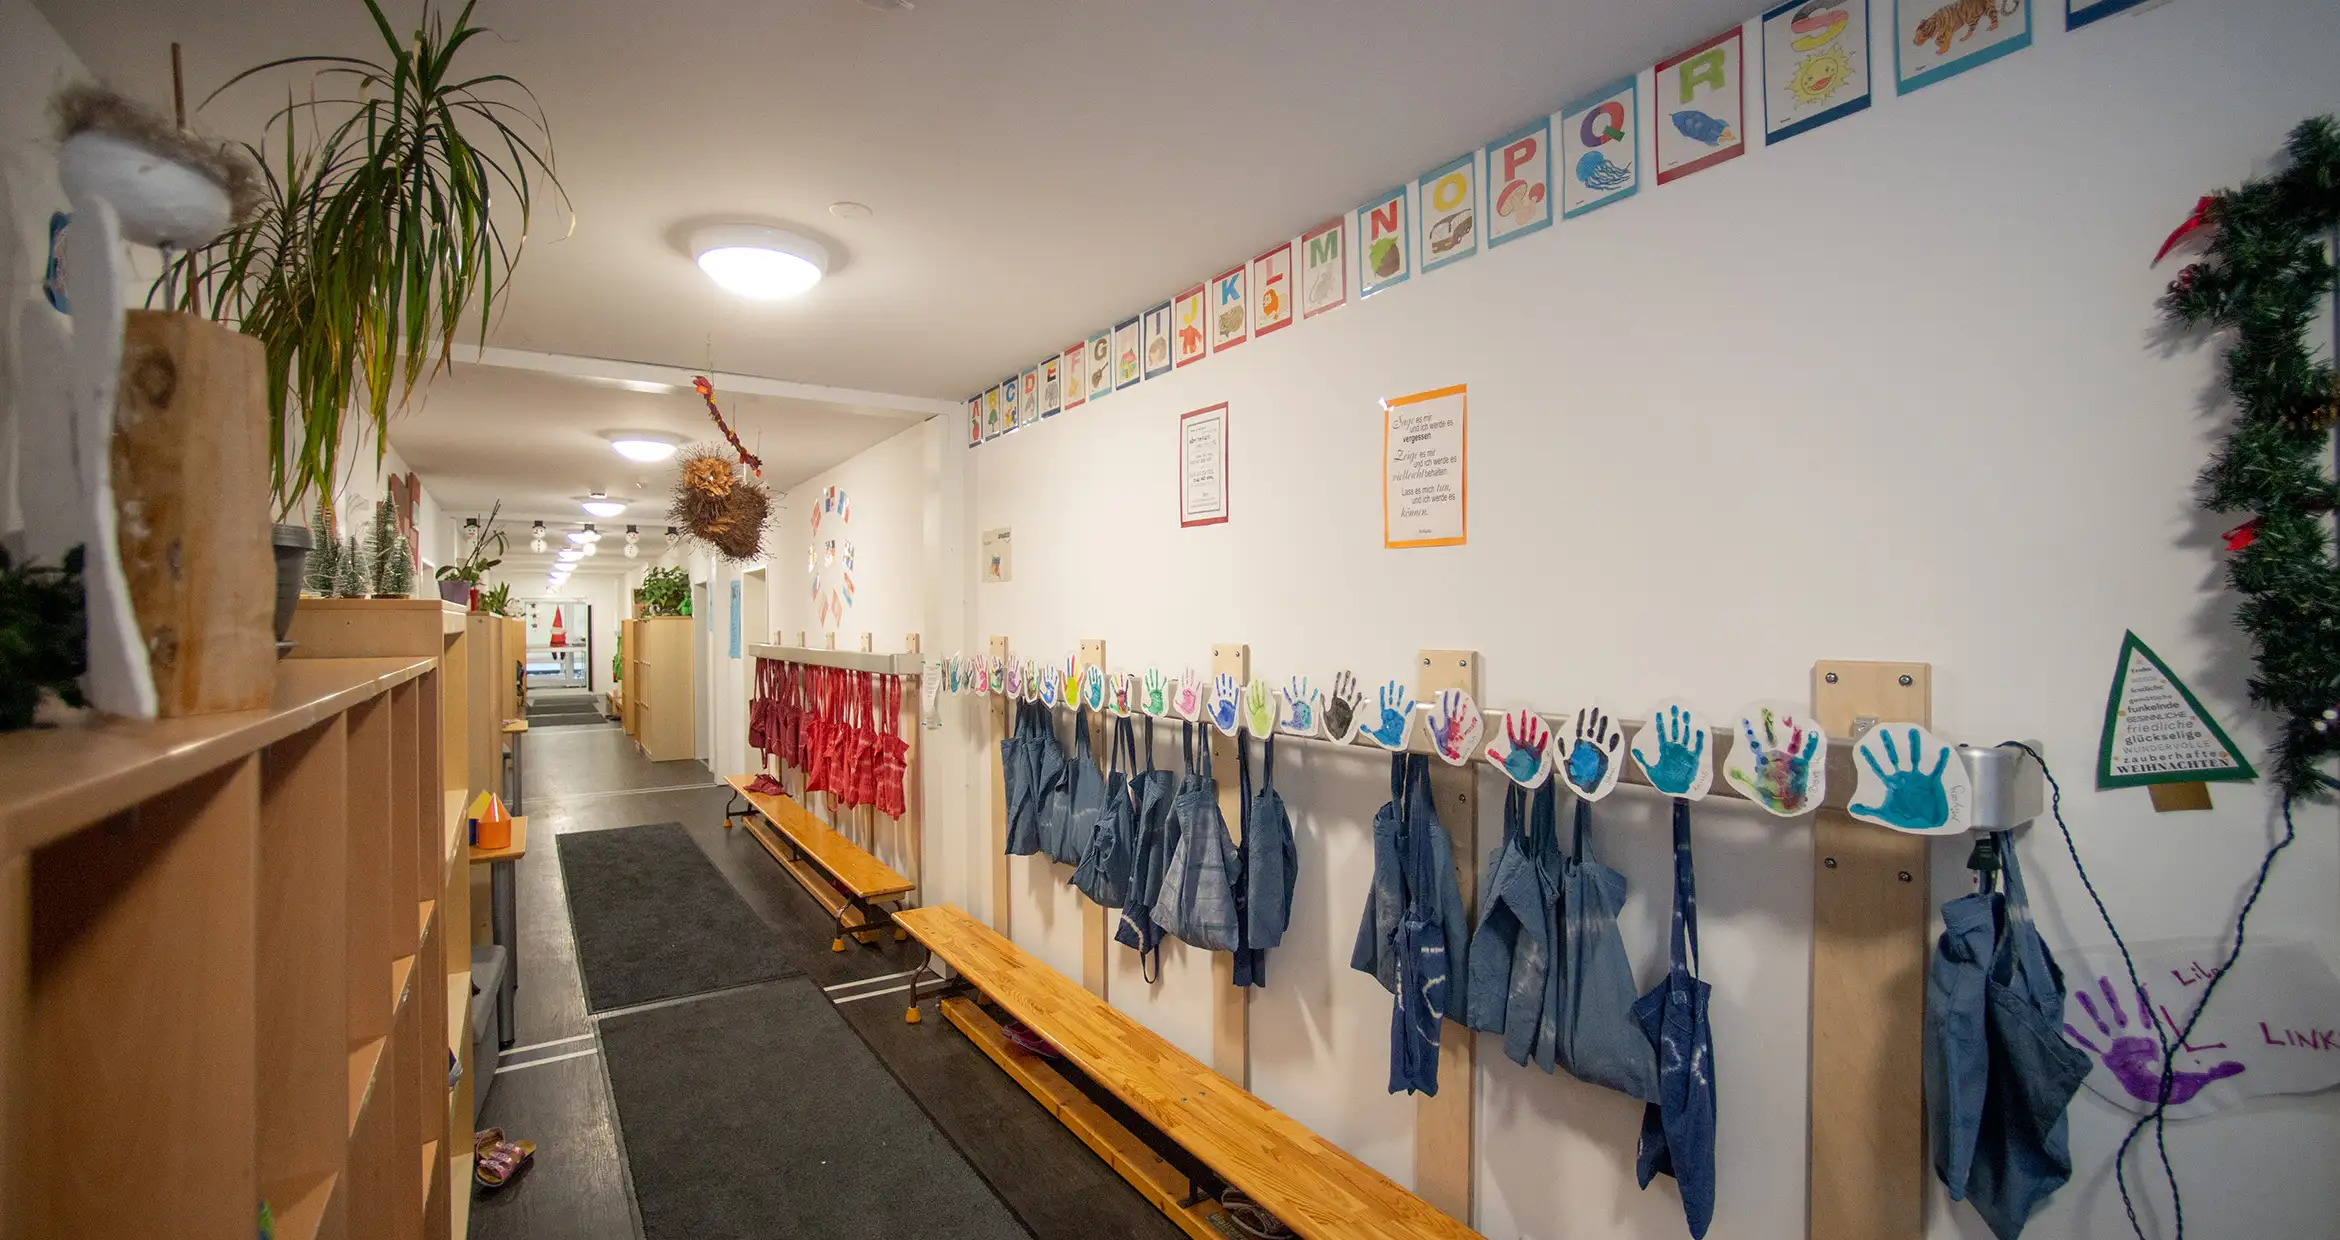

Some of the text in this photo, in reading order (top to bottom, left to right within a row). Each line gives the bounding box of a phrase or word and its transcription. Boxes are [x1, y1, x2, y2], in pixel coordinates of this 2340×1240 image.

[1791, 0, 1849, 52] S
[1678, 47, 1727, 105] R
[1580, 101, 1625, 147] Q
[1504, 138, 1537, 182] P
[1433, 172, 1467, 212] O
[1370, 200, 1398, 240] N
[1310, 229, 1338, 269] M
[1265, 258, 1283, 286] L
[1222, 273, 1240, 305] K
[1184, 296, 1197, 324] J
[1156, 311, 1161, 335] I
[1094, 338, 1107, 361] G
[1047, 360, 1057, 382] E
[1071, 350, 1081, 374] F
[1006, 382, 1016, 402] C
[1025, 373, 1035, 394] D
[972, 400, 980, 419] A
[989, 391, 998, 409] B
[1410, 419, 1453, 433] und ich werde es
[1423, 412, 1432, 422] mir
[1414, 455, 1457, 468] und ich werde es
[1392, 468, 1424, 482] vielleicht
[1401, 487, 1413, 497] Lass
[1415, 487, 1421, 495] es
[1422, 485, 1434, 494] mich
[1412, 496, 1421, 504] und
[1431, 492, 1447, 502] werde
[1448, 493, 1456, 501] es
[2127, 701, 2180, 713] funkelnde
[2126, 711, 2188, 724] BESINNLICHE
[2127, 720, 2194, 735] friedliche
[2122, 739, 2211, 755] WUNDERVOLLE
[2125, 730, 2202, 746] glückselige
[2117, 759, 2229, 774] WEIHNACHTEN
[2124, 750, 2217, 764] zauberhafte
[2258, 1021, 2340, 1051] LINK
